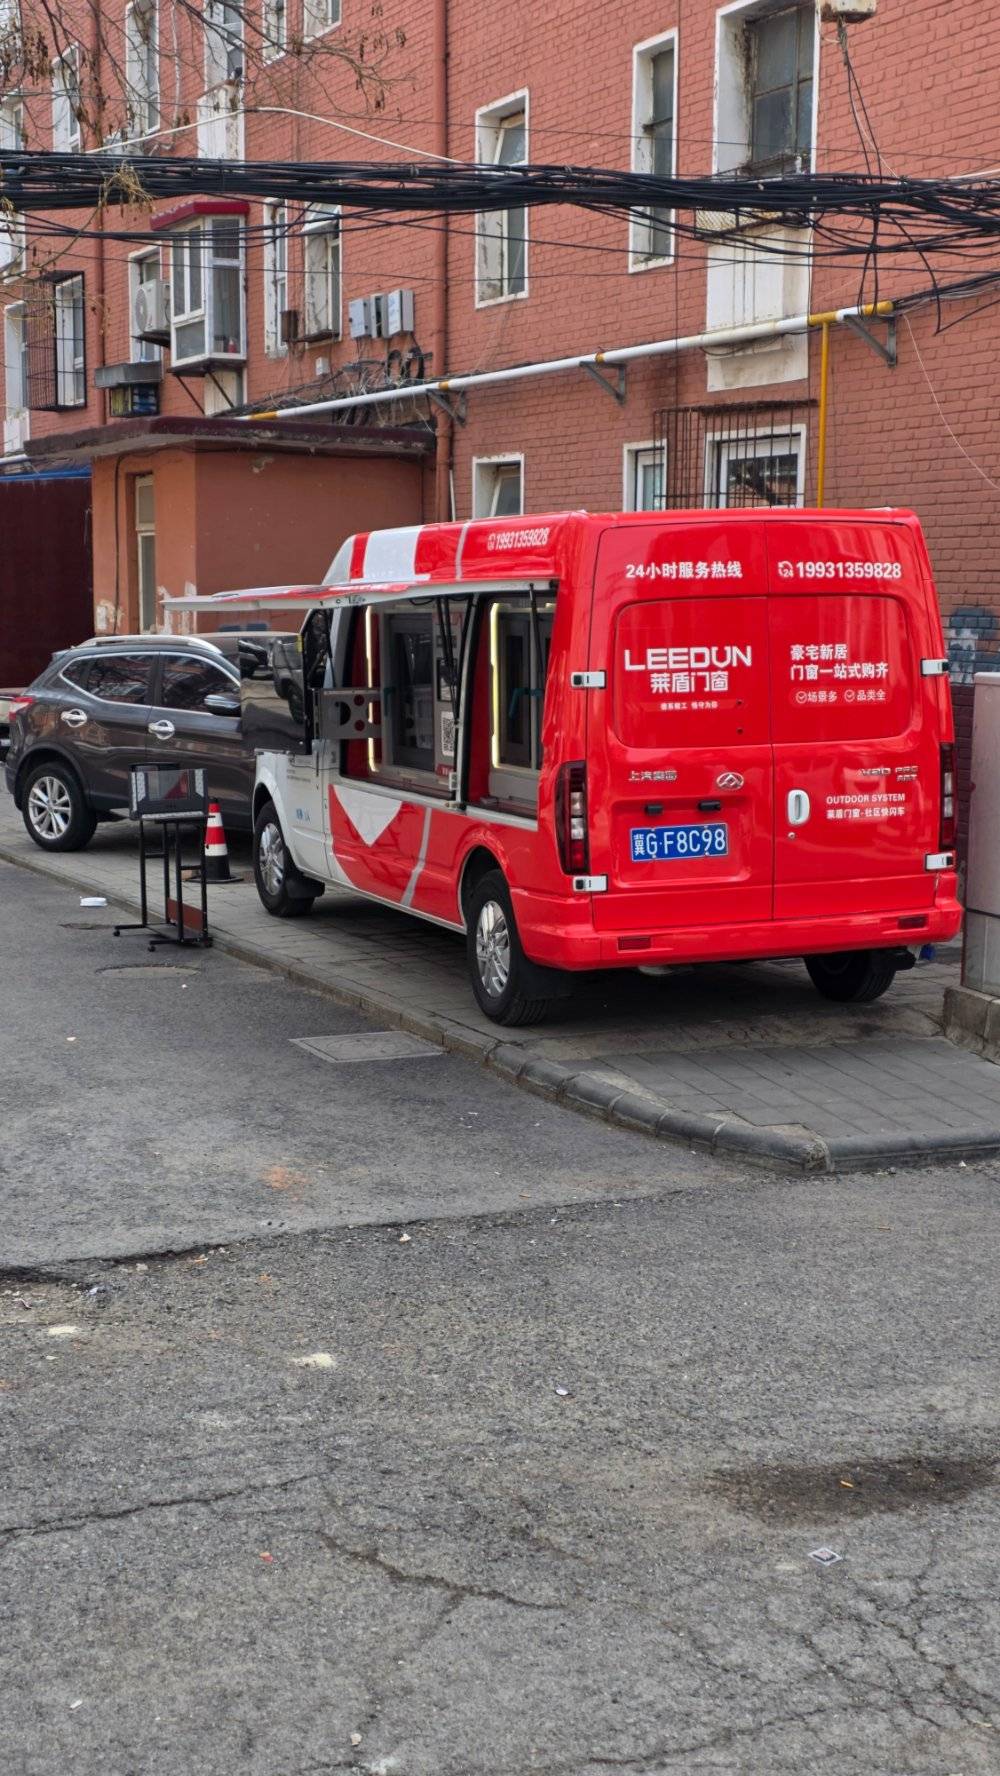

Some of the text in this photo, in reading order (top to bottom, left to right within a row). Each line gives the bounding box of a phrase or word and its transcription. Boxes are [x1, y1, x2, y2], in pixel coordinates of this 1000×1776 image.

[496, 527, 550, 550] 19931359828
[626, 561, 742, 579] 24小时服务热线
[797, 561, 901, 579] 19931359828
[624, 646, 752, 671] LEEDUN
[790, 644, 848, 660] 豪宅新居
[790, 662, 888, 680] 门窗一站式购齐
[650, 671, 728, 694] 莱盾门窗
[807, 689, 887, 703] 场景多 品类全
[826, 793, 905, 804] OUTDOOR SYSTEM
